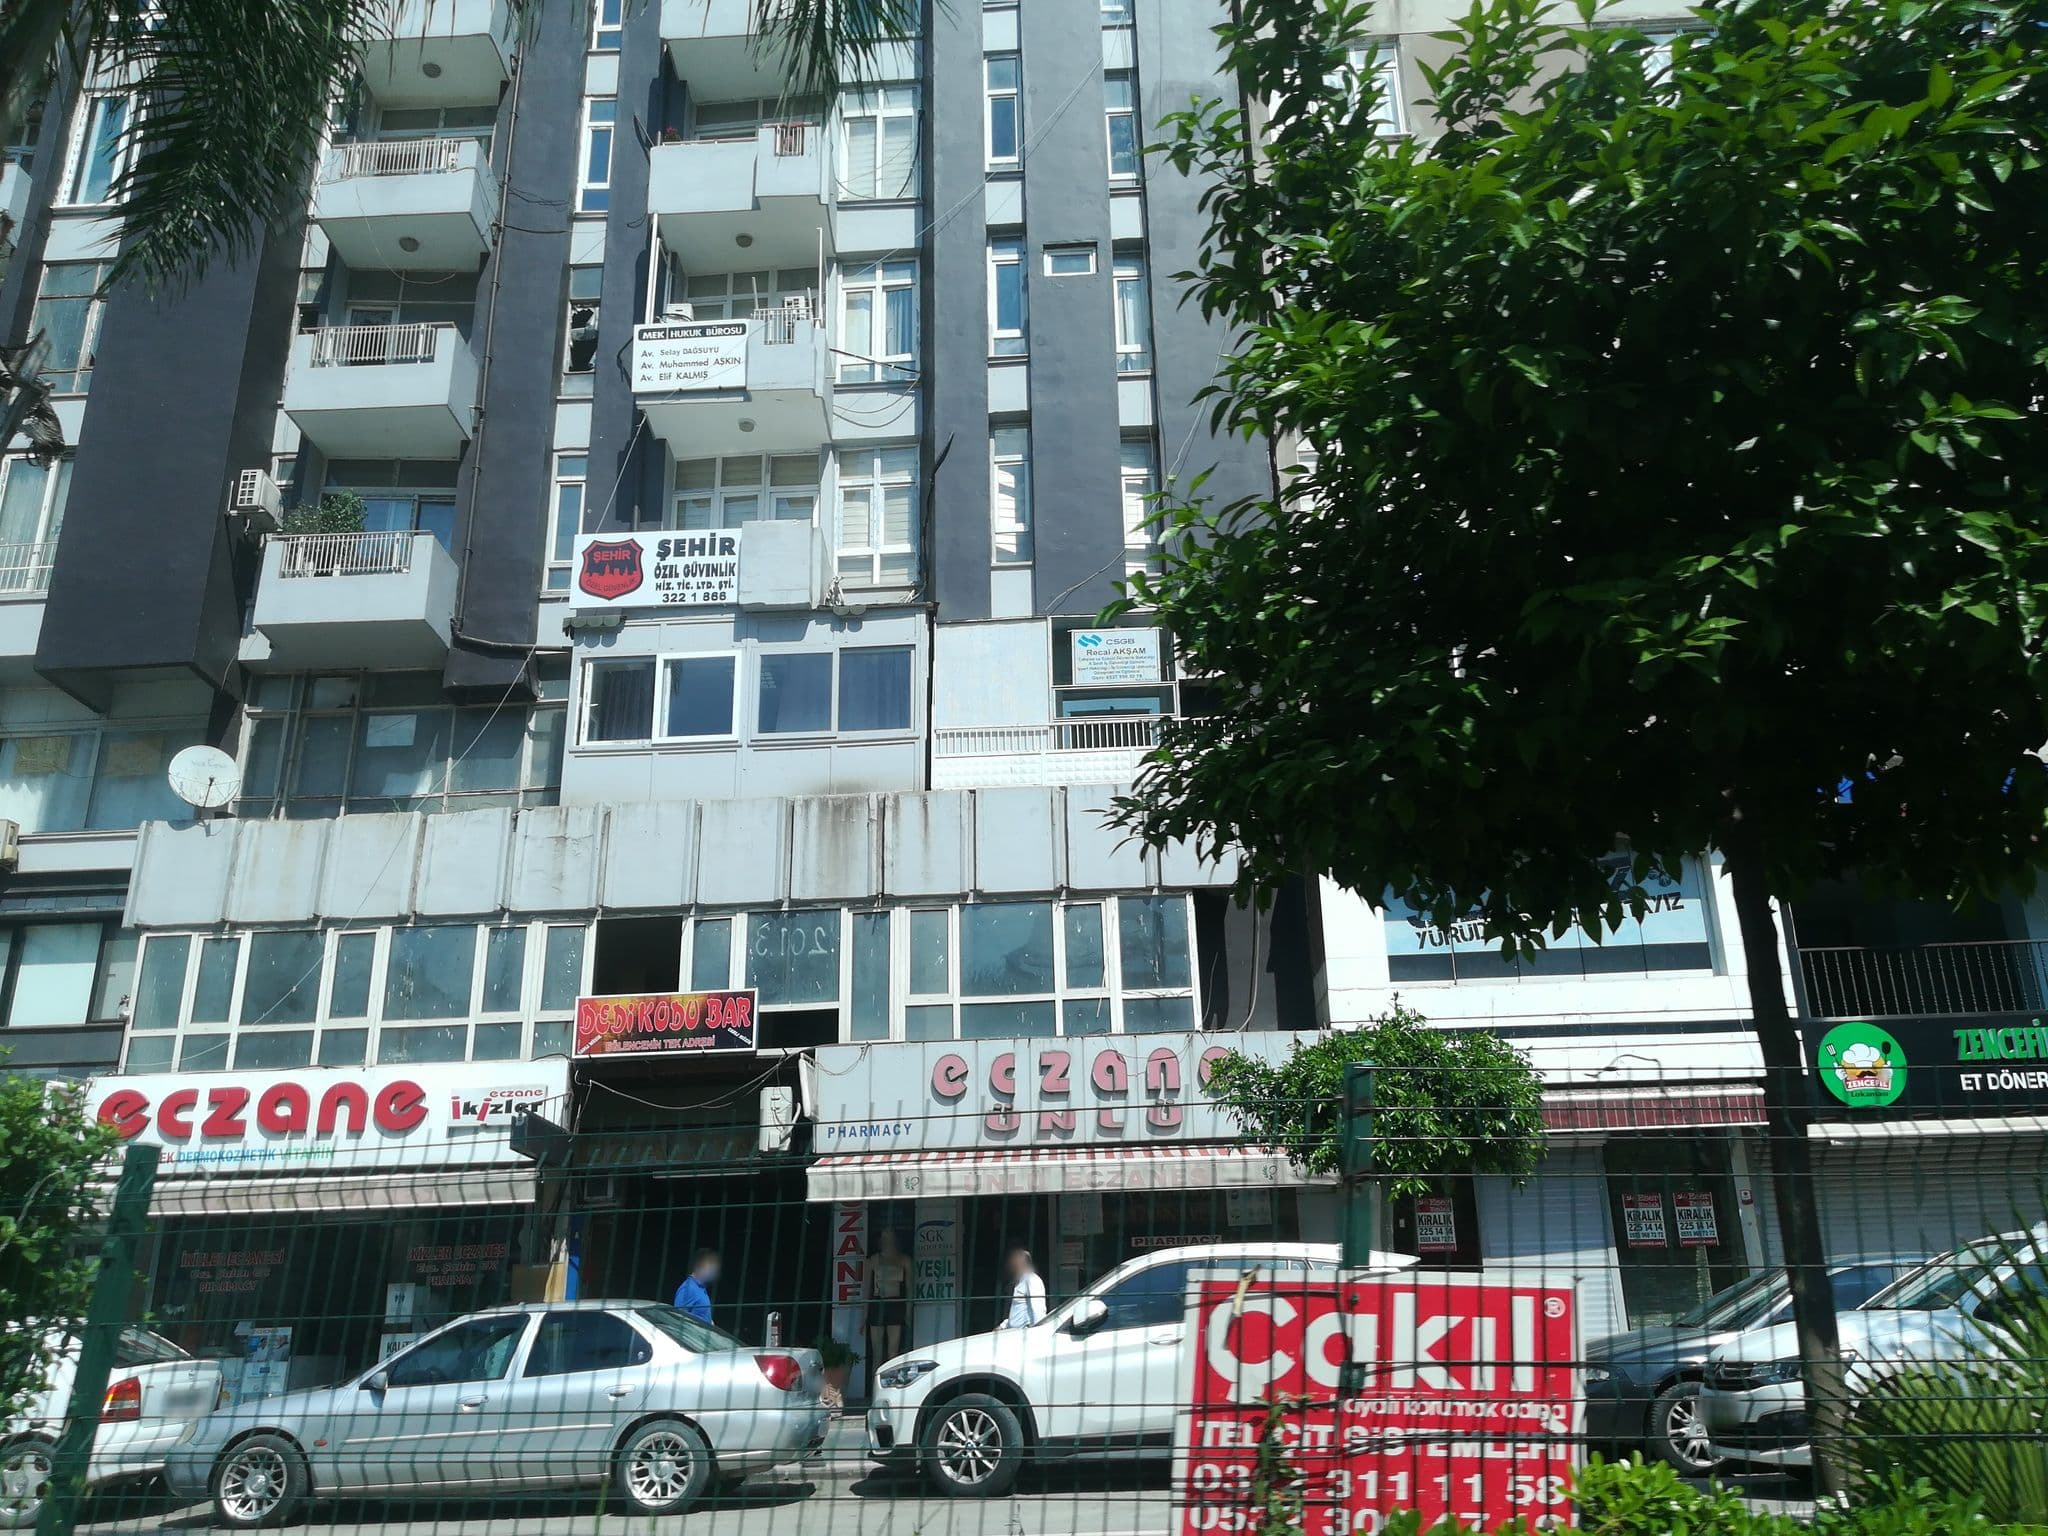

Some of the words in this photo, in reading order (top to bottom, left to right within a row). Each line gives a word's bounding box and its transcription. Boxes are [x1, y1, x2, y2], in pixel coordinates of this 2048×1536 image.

[642, 330, 665, 340] MEK
[670, 328, 702, 338] HUKUK
[705, 325, 743, 337] BÜROSU
[659, 358, 709, 369] Muhammed
[713, 357, 741, 366] AŞKIN
[640, 374, 654, 382] Av.
[658, 372, 672, 381] Elif
[676, 371, 709, 380] KALMIŞ
[655, 532, 737, 562] ŞEHİR
[593, 547, 632, 563] ŞEHİR
[654, 562, 680, 580] ÖZEL
[683, 560, 737, 579] GÜVENLİK
[655, 578, 675, 592] HİZ.
[676, 579, 694, 591] TİC.
[696, 580, 715, 590] LTD.
[718, 577, 735, 591] ŞTİ.
[662, 592, 686, 603] 322
[691, 592, 697, 603] 1
[1112, 647, 1147, 656] AKŞAM
[705, 996, 751, 1029] BAR
[1959, 1073, 1982, 1092] ET
[1987, 1069, 2048, 1090] DÖNER
[489, 1088, 544, 1098] eczane
[97, 1080, 429, 1142] eczane
[984, 1098, 1183, 1133] ÜNLÜ
[827, 1123, 912, 1139] PHARMACY
[1418, 1213, 1453, 1226] KİRALIK
[1626, 1210, 1662, 1222] KİRALIK
[1677, 1208, 1714, 1220] KİRALIK
[1420, 1228, 1434, 1236] 225
[1436, 1227, 1444, 1235] 14
[1628, 1223, 1643, 1232] 225
[1644, 1223, 1653, 1231] 14
[1655, 1223, 1663, 1231] 14
[1680, 1222, 1694, 1231] 225
[1696, 1222, 1704, 1230] 14
[919, 1229, 945, 1242] SGK
[1134, 1236, 1220, 1247] PHARMACY
[915, 1259, 956, 1280] YEŞİL
[916, 1282, 955, 1300] KART
[1207, 1292, 1535, 1404] Çakıl
[1403, 1397, 1499, 1418] korumak
[1197, 1421, 1259, 1448] TEL
[1325, 1468, 1409, 1501] 311
[1433, 1472, 1484, 1503] 11
[1504, 1475, 1566, 1505] 58
